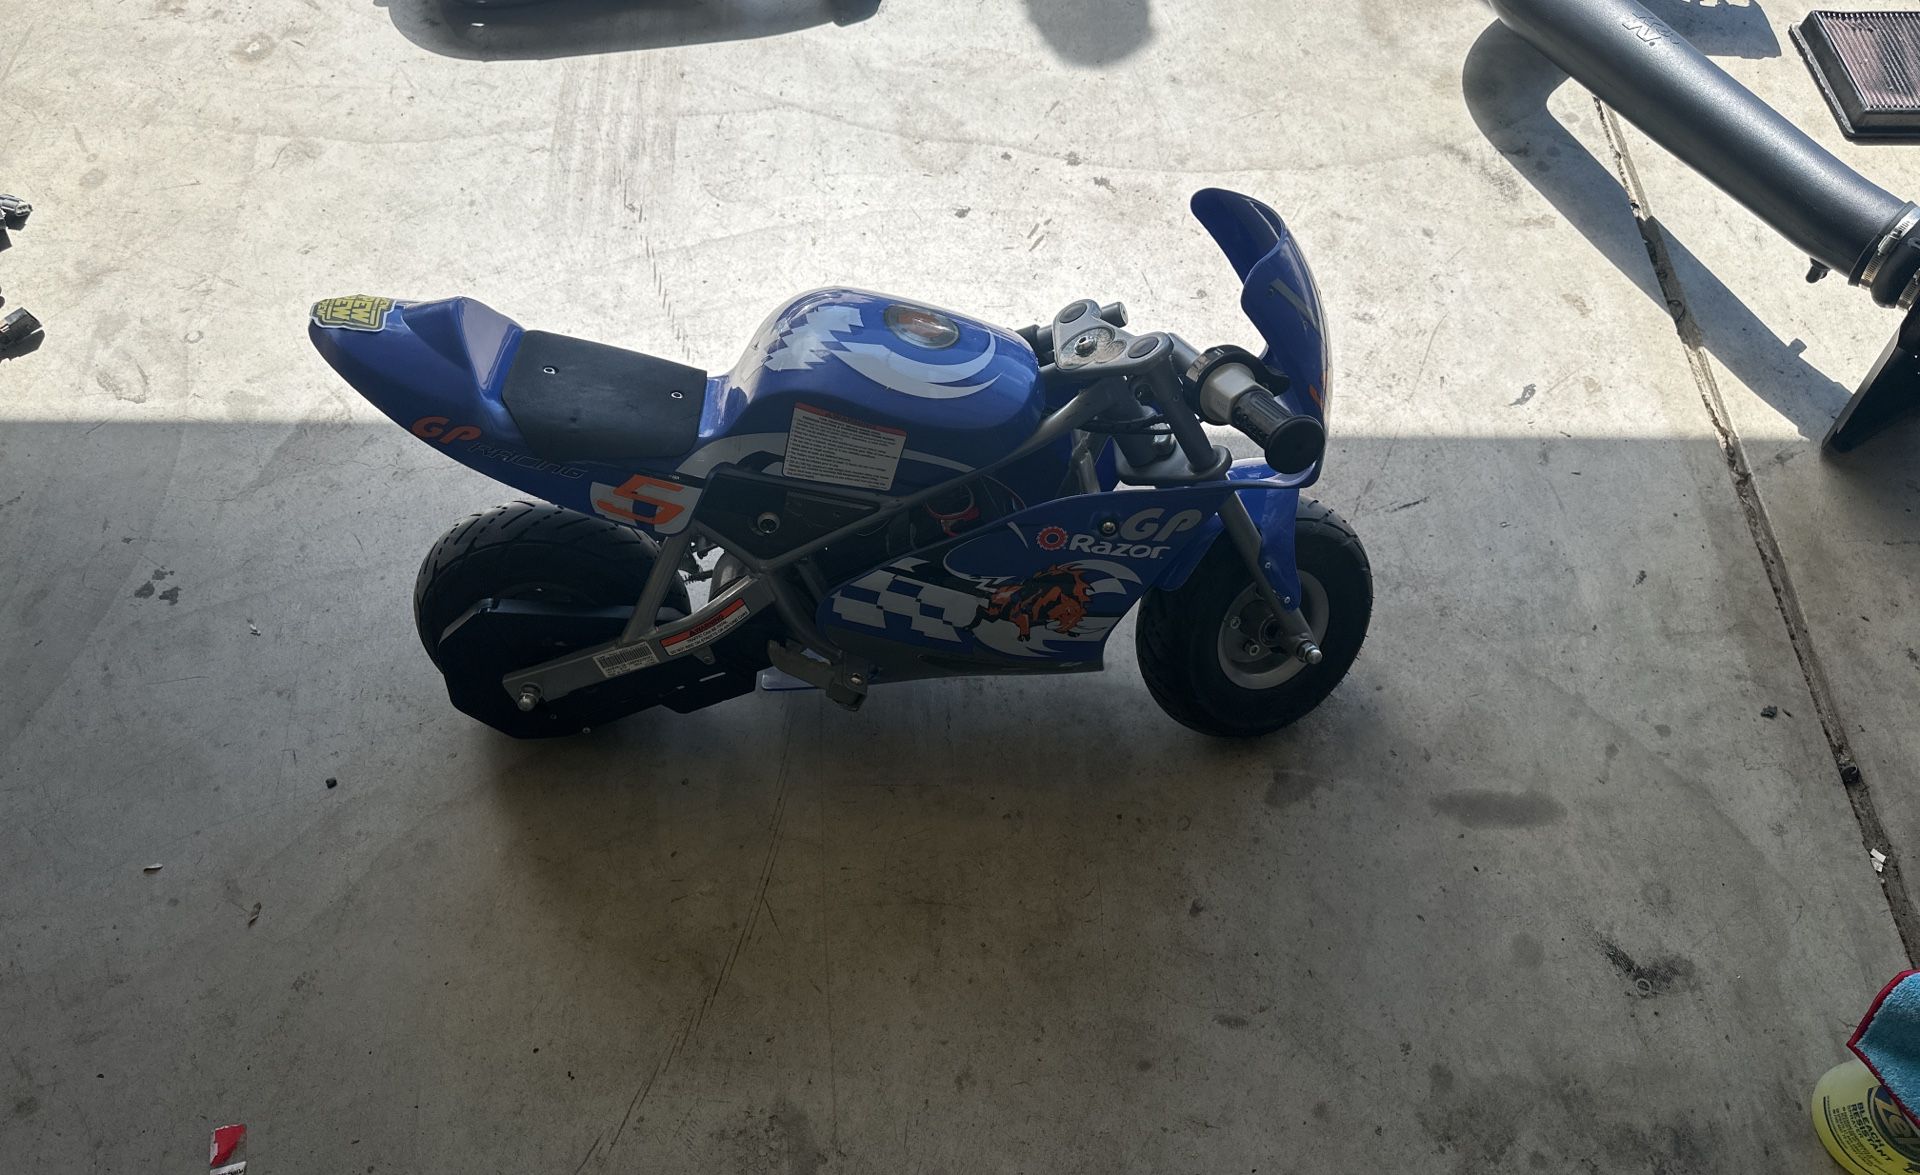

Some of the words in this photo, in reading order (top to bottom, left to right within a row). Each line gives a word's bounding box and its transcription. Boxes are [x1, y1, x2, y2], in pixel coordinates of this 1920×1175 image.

[410, 416, 482, 444] GP
[469, 441, 589, 479] RACING
[597, 474, 687, 525] 5
[1069, 533, 1171, 559] Razor
[1120, 508, 1202, 542] GP
[1851, 1103, 1894, 1161] RESISTANT
[1857, 1102, 1885, 1147] BLEACH
